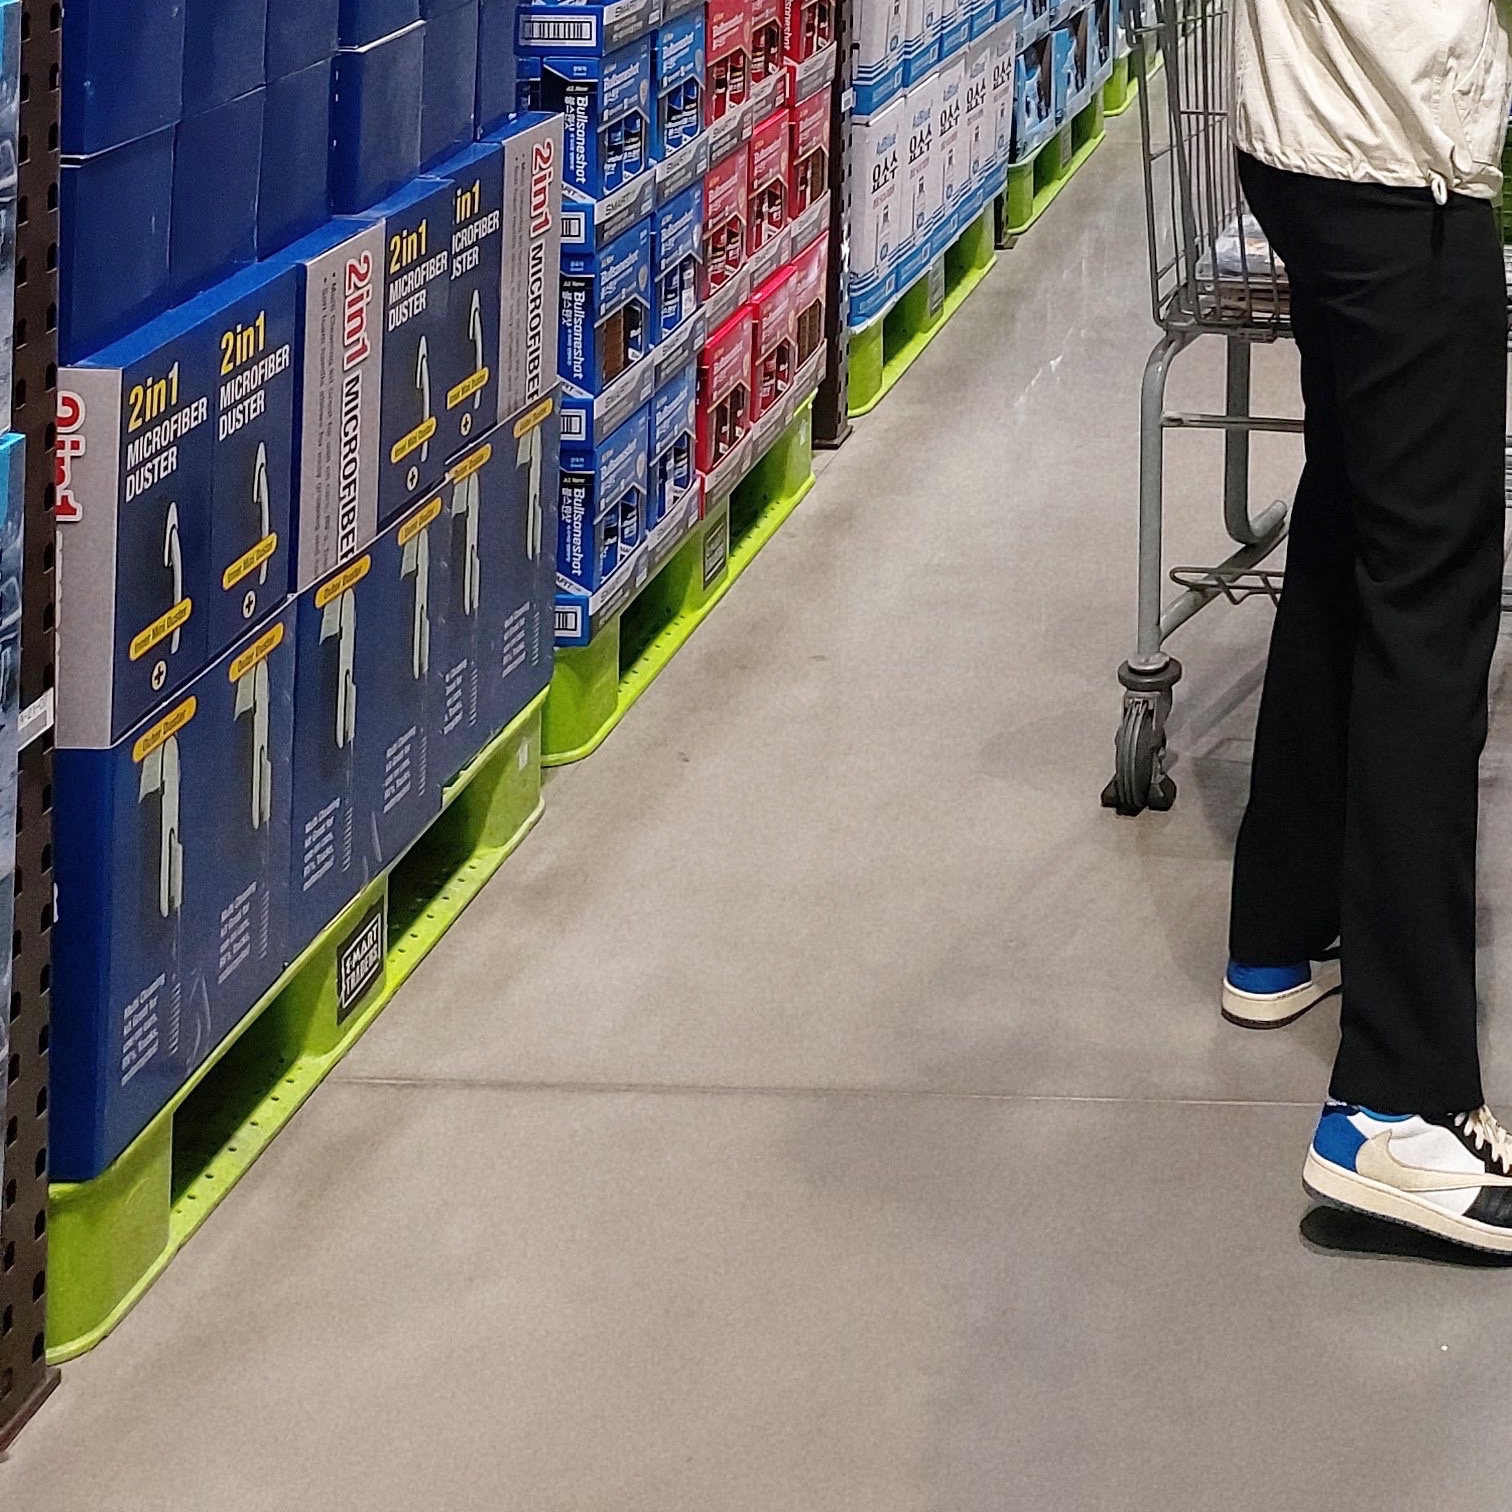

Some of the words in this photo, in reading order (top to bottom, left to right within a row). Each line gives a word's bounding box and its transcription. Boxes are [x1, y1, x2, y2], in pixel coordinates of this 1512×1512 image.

[965, 77, 987, 116] 요소수
[992, 55, 1012, 92] 요소수
[576, 94, 588, 185] Bullsoneshot
[908, 123, 932, 166] 요소수
[939, 99, 961, 138] 요소수
[531, 137, 554, 239] 2in1
[871, 149, 898, 195] 요소수
[390, 218, 428, 275] 2in1
[388, 250, 448, 307] MICROFIBER
[343, 249, 373, 372] 2in1
[388, 288, 427, 333] DUSTER
[573, 290, 585, 380] Bullsoneshot
[219, 310, 267, 376] 2in1
[127, 361, 180, 434] 2in1
[219, 343, 290, 412] MICROFIBER
[127, 396, 209, 472] MICROFIBER
[218, 389, 265, 442] DUSTER
[125, 445, 178, 504] DUSTER
[571, 486, 585, 577] Bullsoneshot
[151, 620, 166, 639] Mini
[166, 606, 189, 630] Duster
[162, 708, 187, 730] Duster
